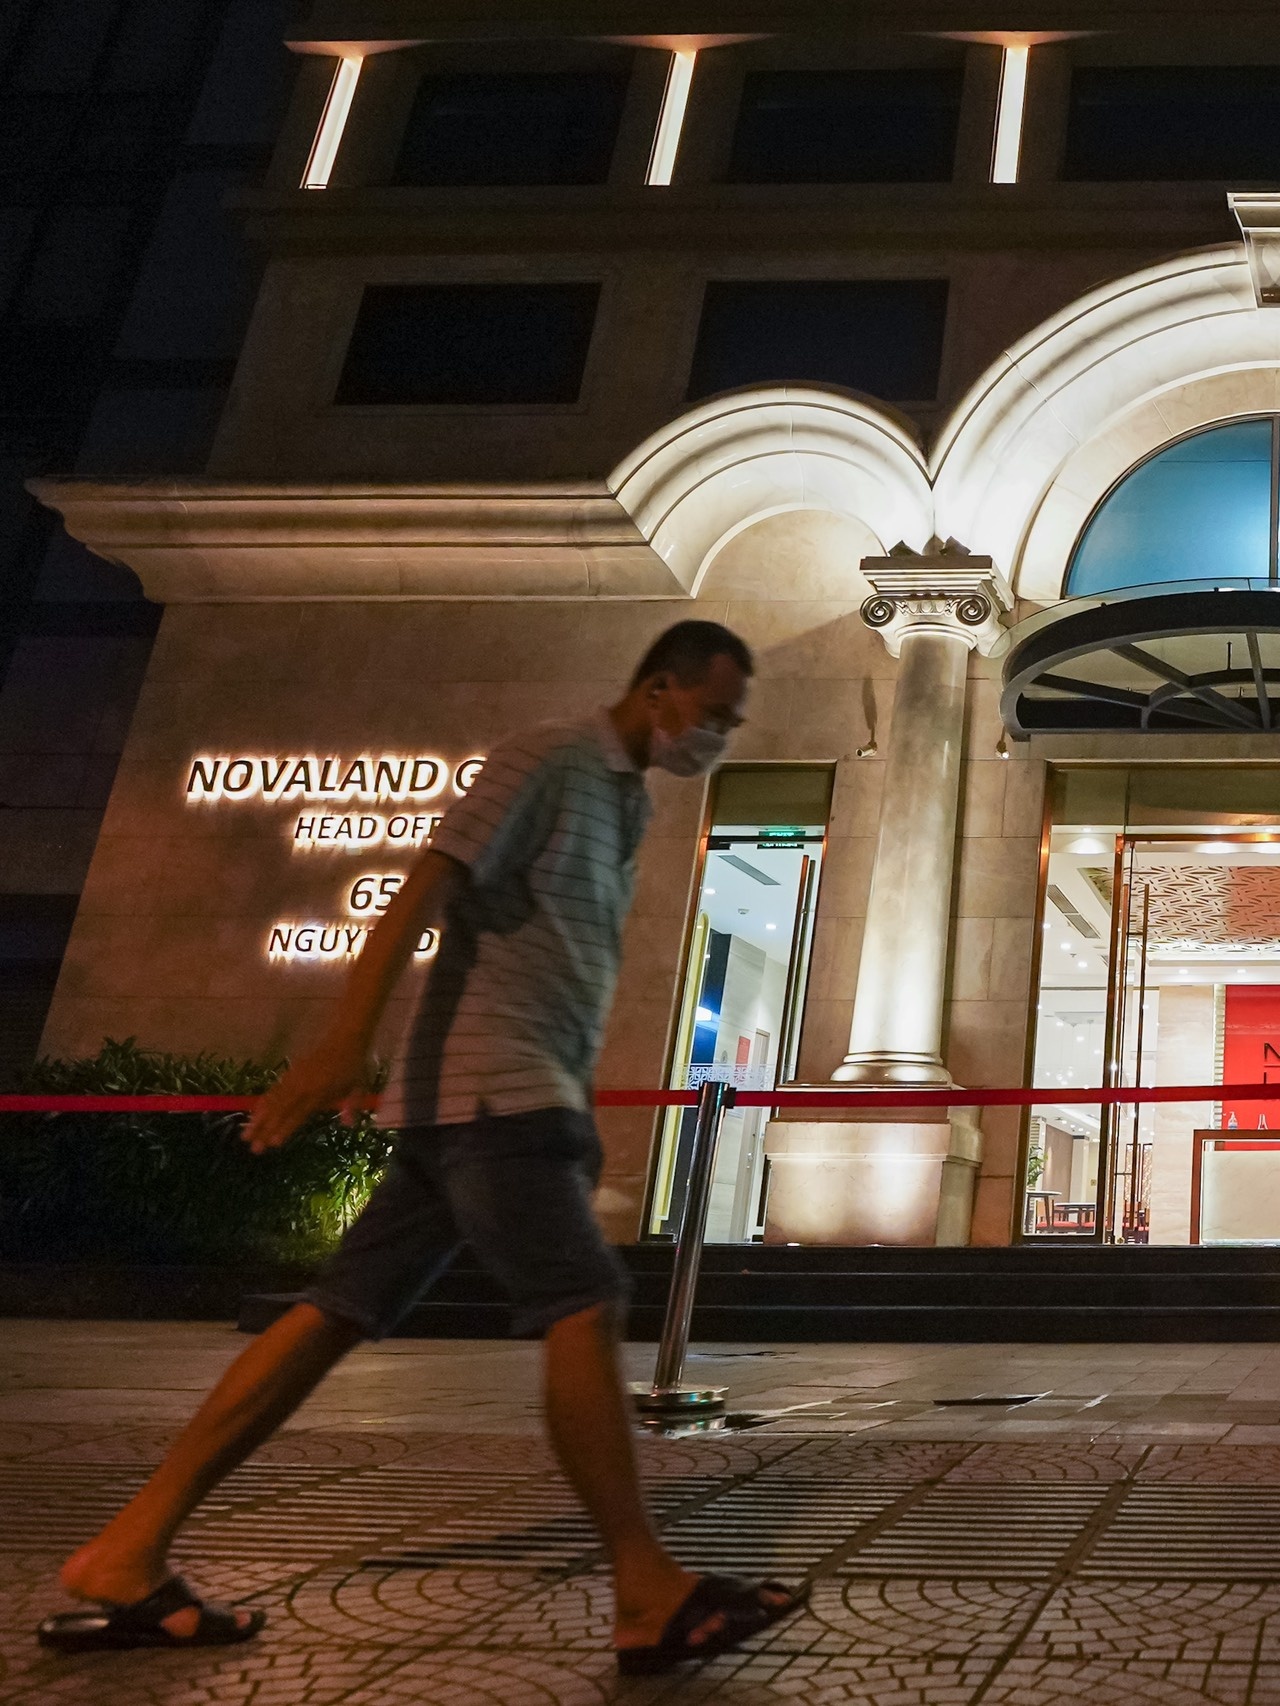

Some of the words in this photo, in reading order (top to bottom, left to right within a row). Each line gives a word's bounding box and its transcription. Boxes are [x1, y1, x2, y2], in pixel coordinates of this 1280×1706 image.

[187, 759, 439, 792] NOVALAND
[455, 759, 486, 792] G
[295, 816, 377, 839] HEAD
[387, 816, 445, 839] OFF
[350, 877, 402, 911] 65
[269, 928, 376, 952] NGUY
[413, 928, 436, 952] D
